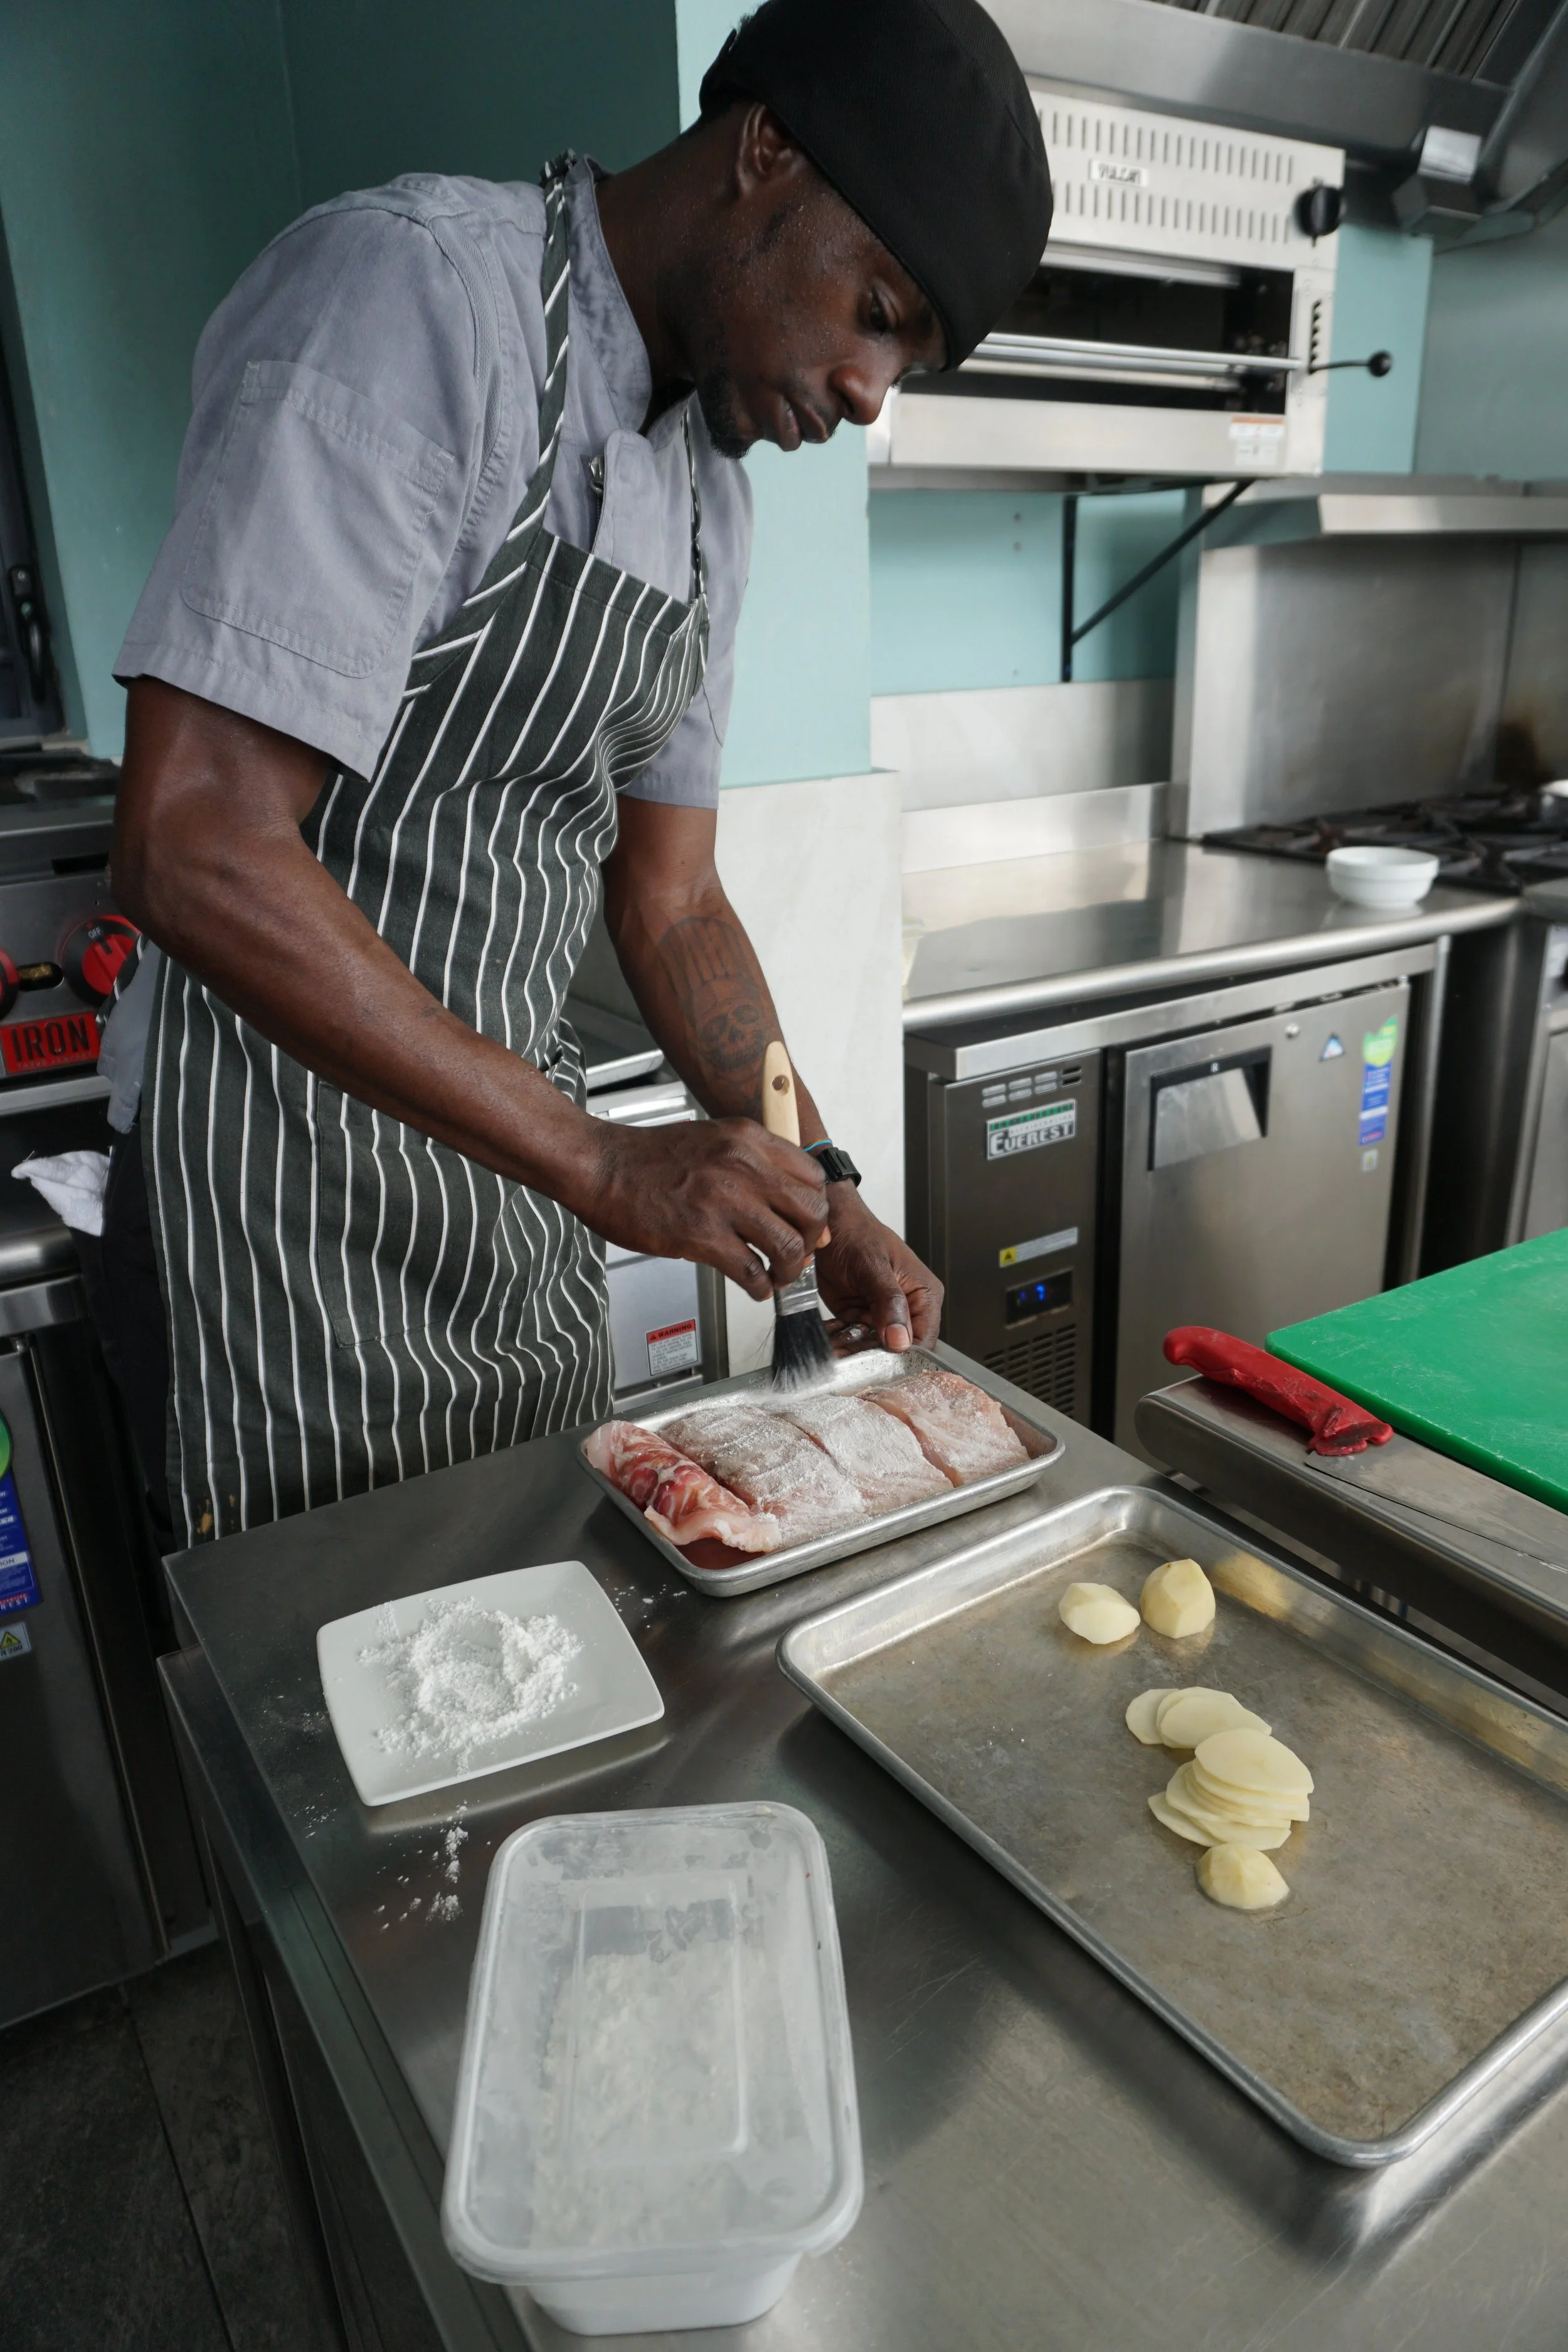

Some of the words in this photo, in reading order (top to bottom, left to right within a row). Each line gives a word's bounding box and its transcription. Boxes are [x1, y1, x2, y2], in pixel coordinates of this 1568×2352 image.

[88, 926, 100, 938] OFF
[10, 1017, 90, 1061] IRON
[990, 1123, 1071, 1155] EVEREST
[657, 1323, 692, 1338] WARNING
